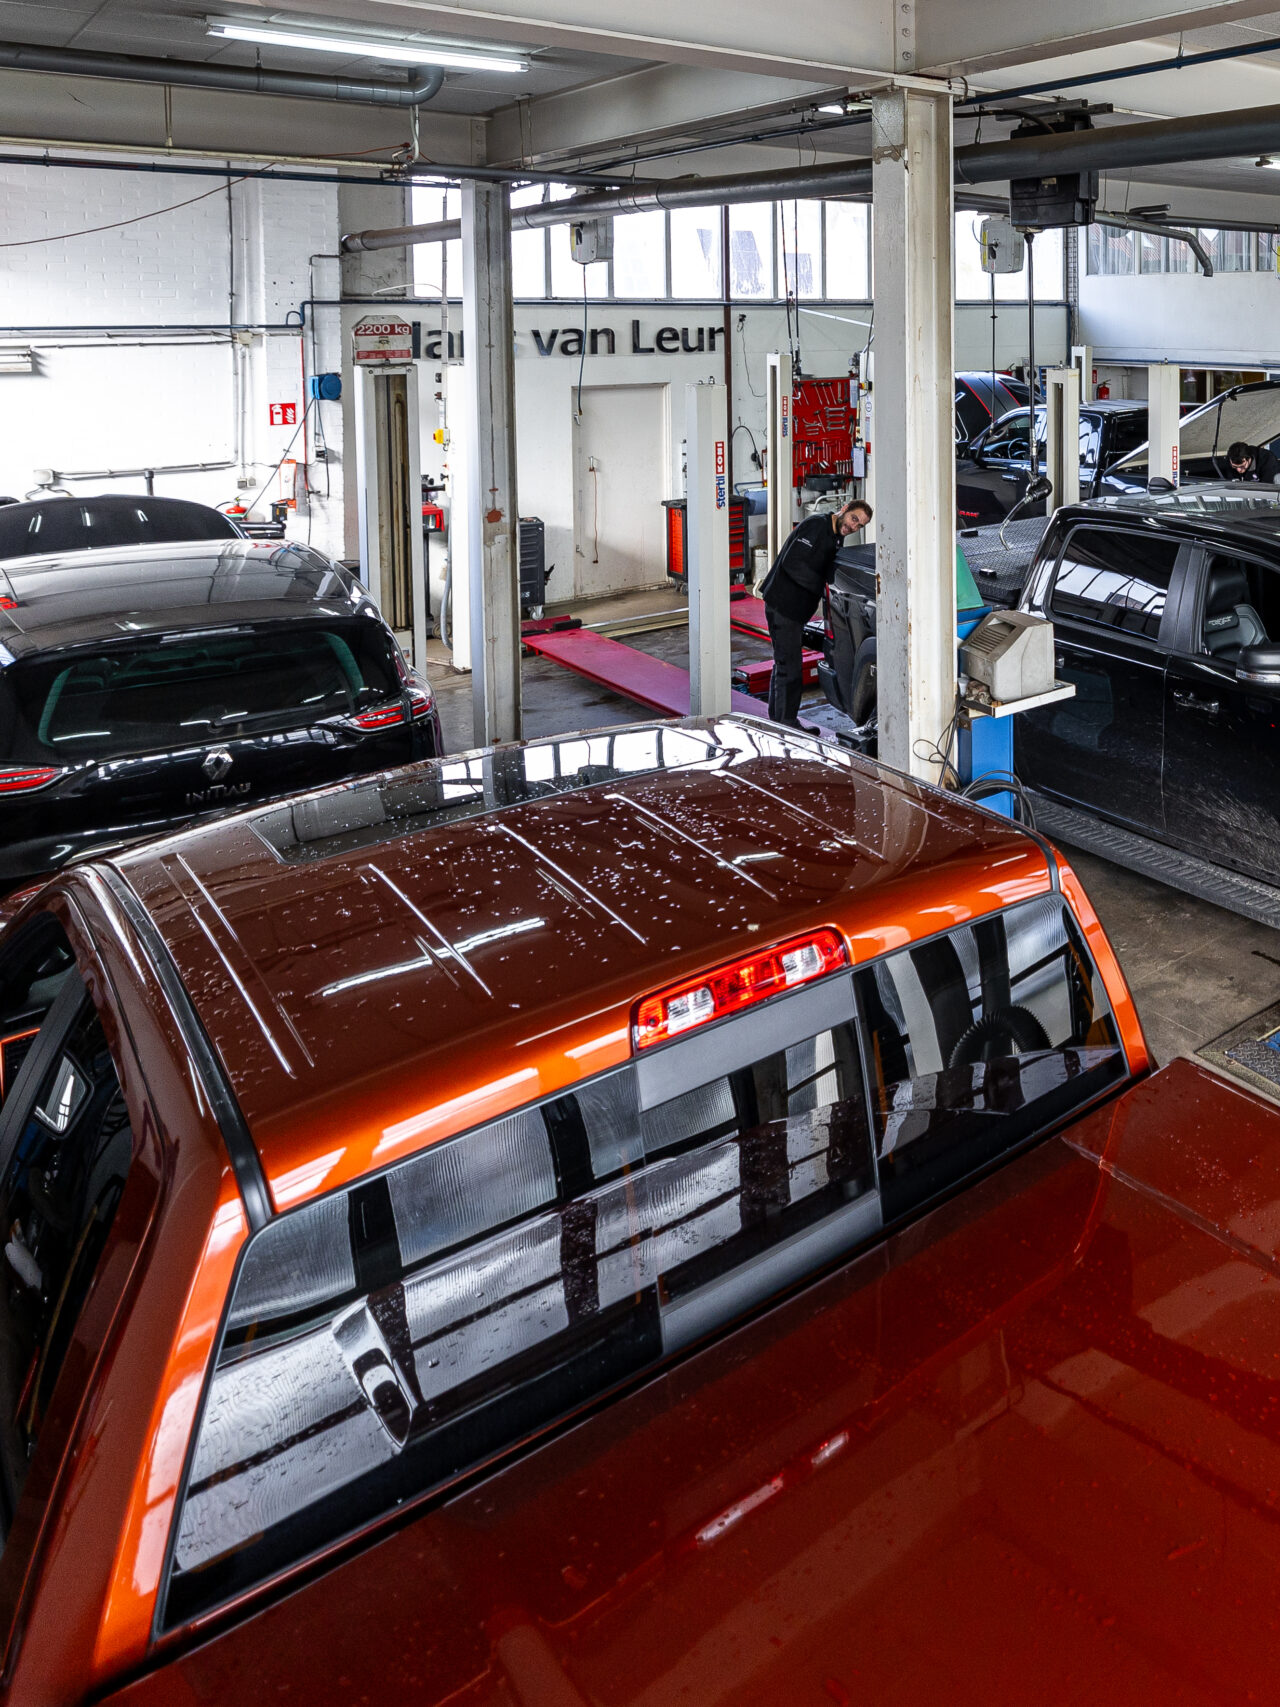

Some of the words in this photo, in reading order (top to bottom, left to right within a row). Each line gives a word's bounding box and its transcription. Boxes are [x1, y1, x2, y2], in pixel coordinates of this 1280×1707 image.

[356, 324, 391, 334] 2200
[394, 324, 410, 335] kg
[532, 327, 615, 356] van
[631, 319, 724, 354] Leur
